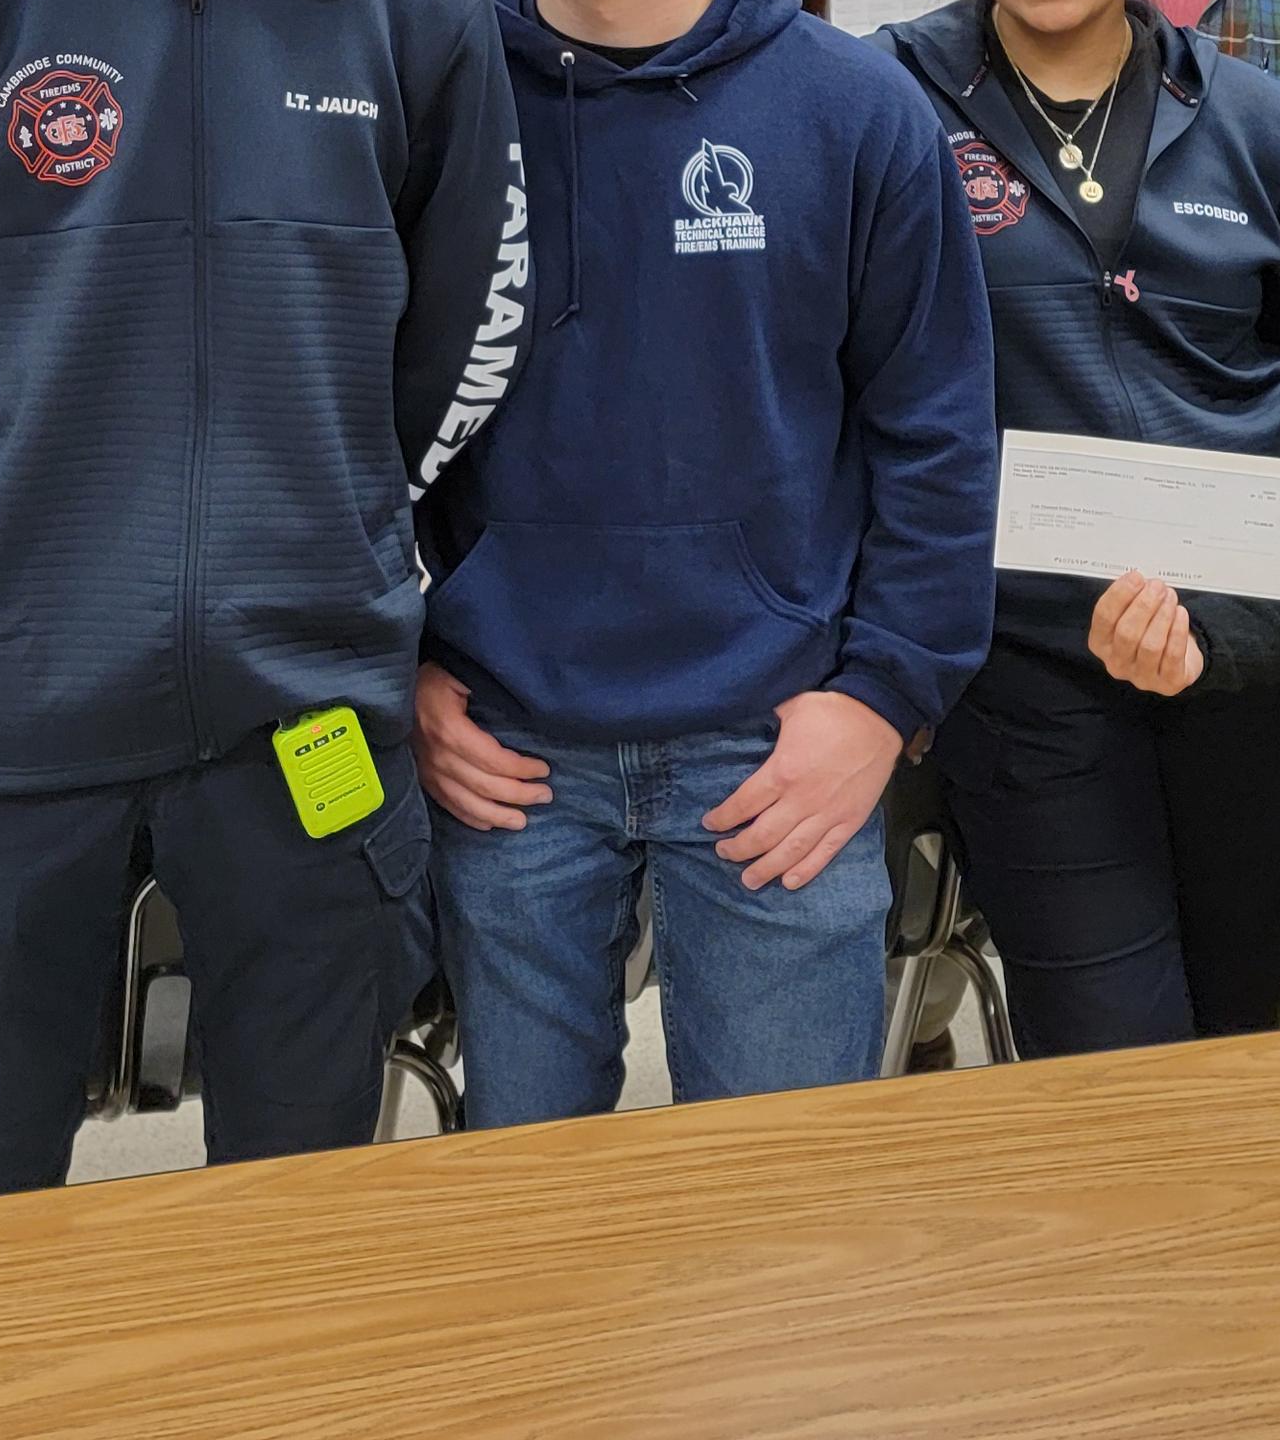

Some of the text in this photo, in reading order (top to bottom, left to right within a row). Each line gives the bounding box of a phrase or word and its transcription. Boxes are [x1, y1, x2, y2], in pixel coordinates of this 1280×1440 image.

[55, 53, 124, 84] COMMUNITY
[39, 82, 81, 100] FIRE/EMS
[286, 91, 379, 120] LT. JAUCH
[54, 157, 96, 175] DISTRICT
[674, 214, 765, 231] BLACKHAWK
[1173, 201, 1249, 226] ESCOBEDO
[675, 225, 766, 242] TECHNICAL COLLEGE
[675, 237, 766, 255] FIRE/EMS TRAINING
